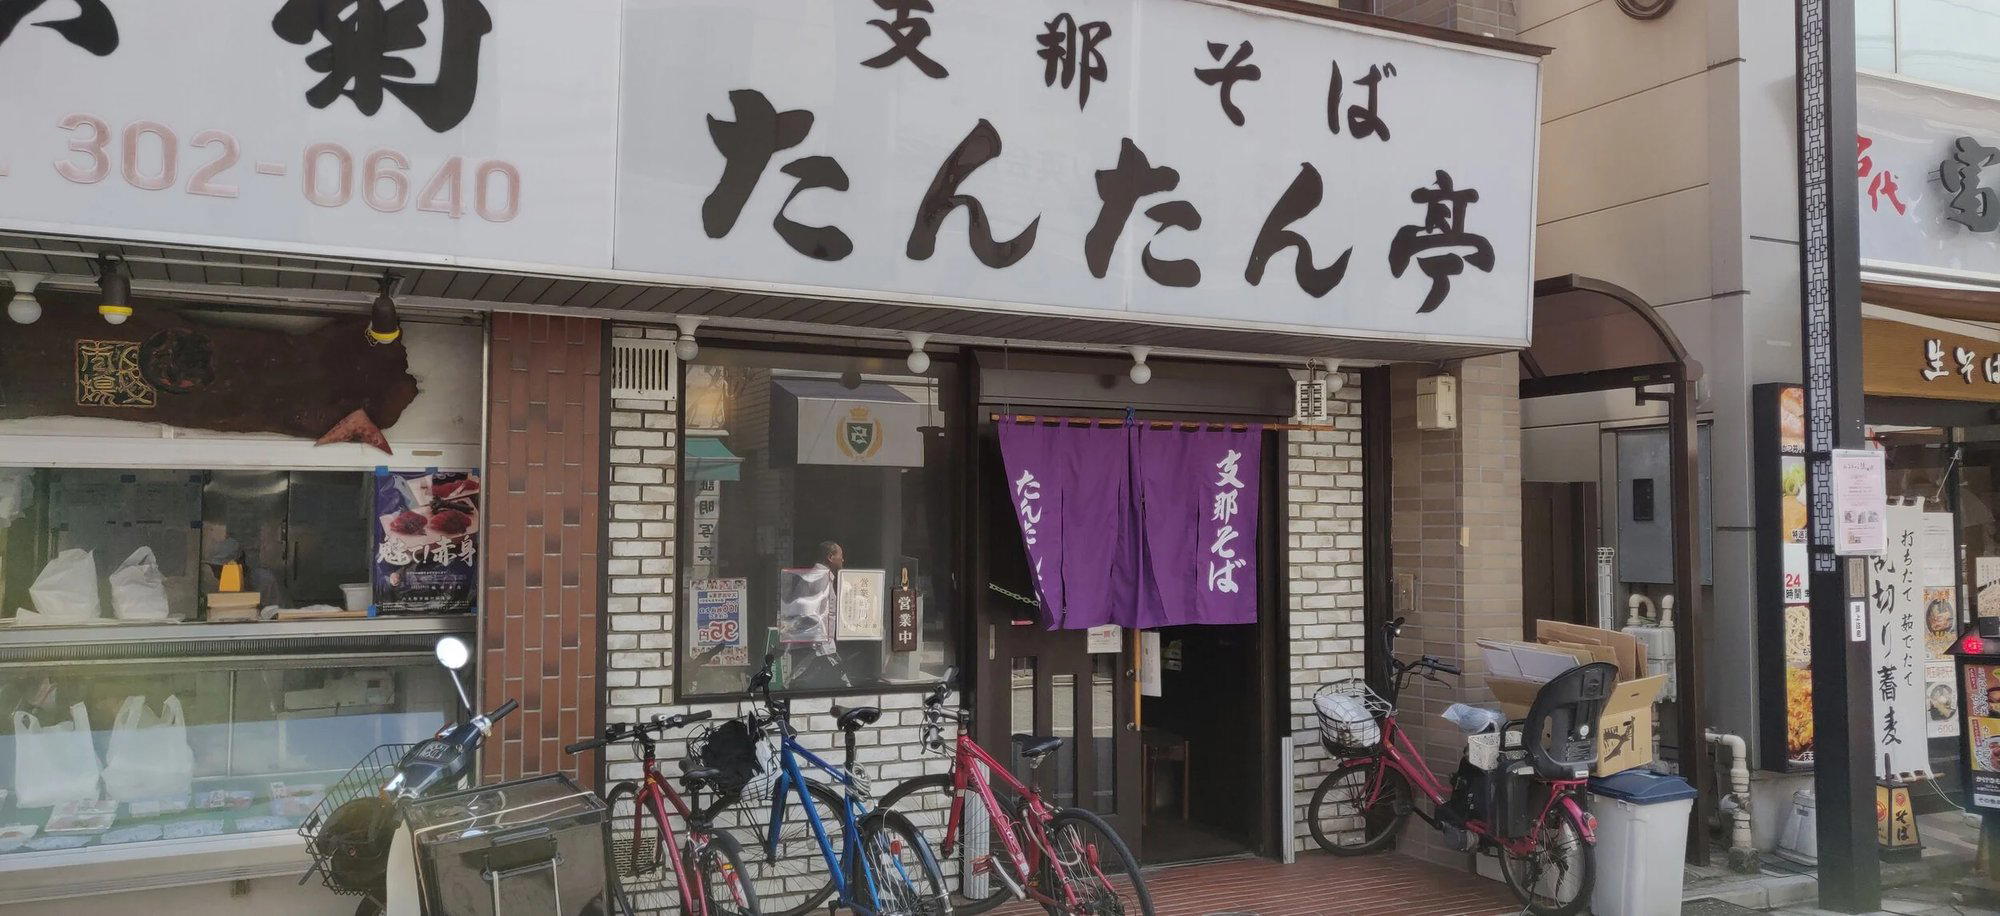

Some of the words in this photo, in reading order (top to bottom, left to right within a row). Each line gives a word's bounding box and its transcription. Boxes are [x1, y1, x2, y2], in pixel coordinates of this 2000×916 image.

[860, 0, 1398, 142] 支那そば
[53, 112, 521, 222] 302-0640
[702, 88, 1495, 314] たんたん亭
[1208, 448, 1246, 594] 支那そば
[1901, 530, 1914, 602] 打ちたて
[898, 596, 913, 645] 営業中
[1785, 574, 1801, 588] 24
